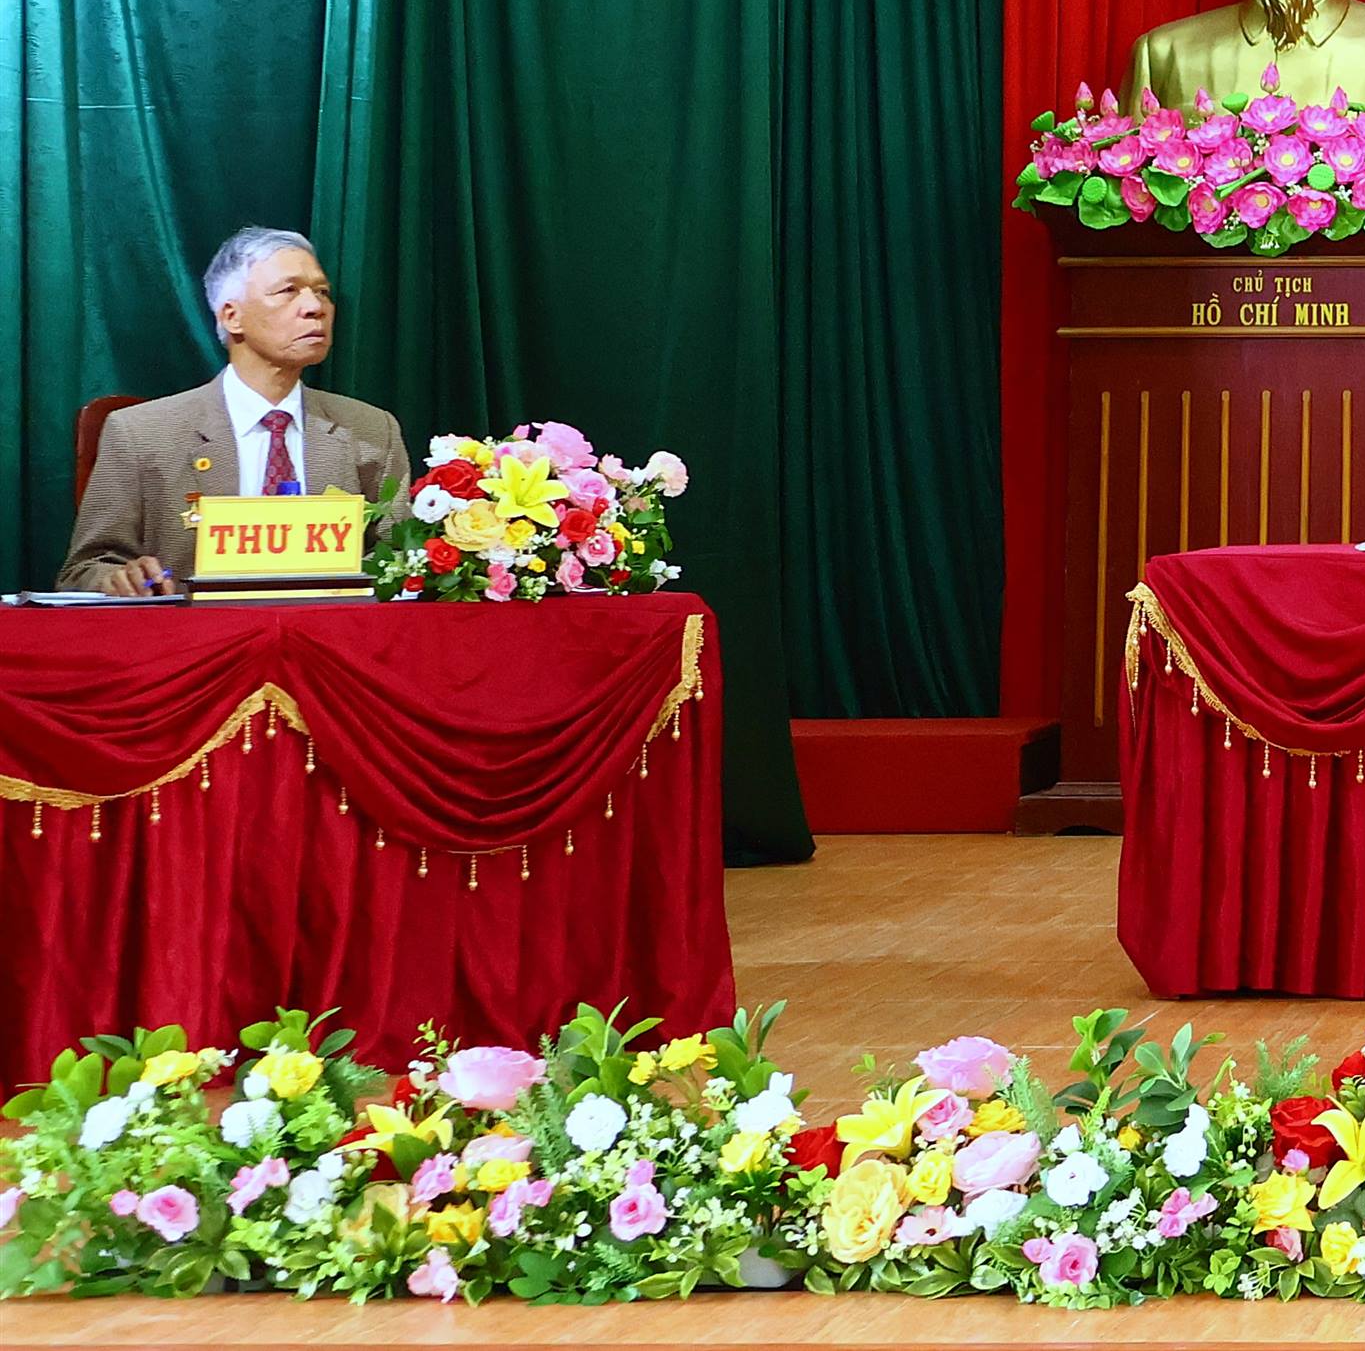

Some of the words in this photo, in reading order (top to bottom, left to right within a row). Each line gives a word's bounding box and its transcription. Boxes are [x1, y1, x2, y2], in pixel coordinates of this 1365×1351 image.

[1233, 269, 1265, 293] CHỦ
[1274, 277, 1313, 298] TỊCH
[1191, 292, 1222, 326] HỒ
[1239, 295, 1280, 326] CHÍ
[1294, 302, 1350, 326] MINH
[209, 523, 293, 555] THƯ
[304, 516, 353, 554] KÝ
